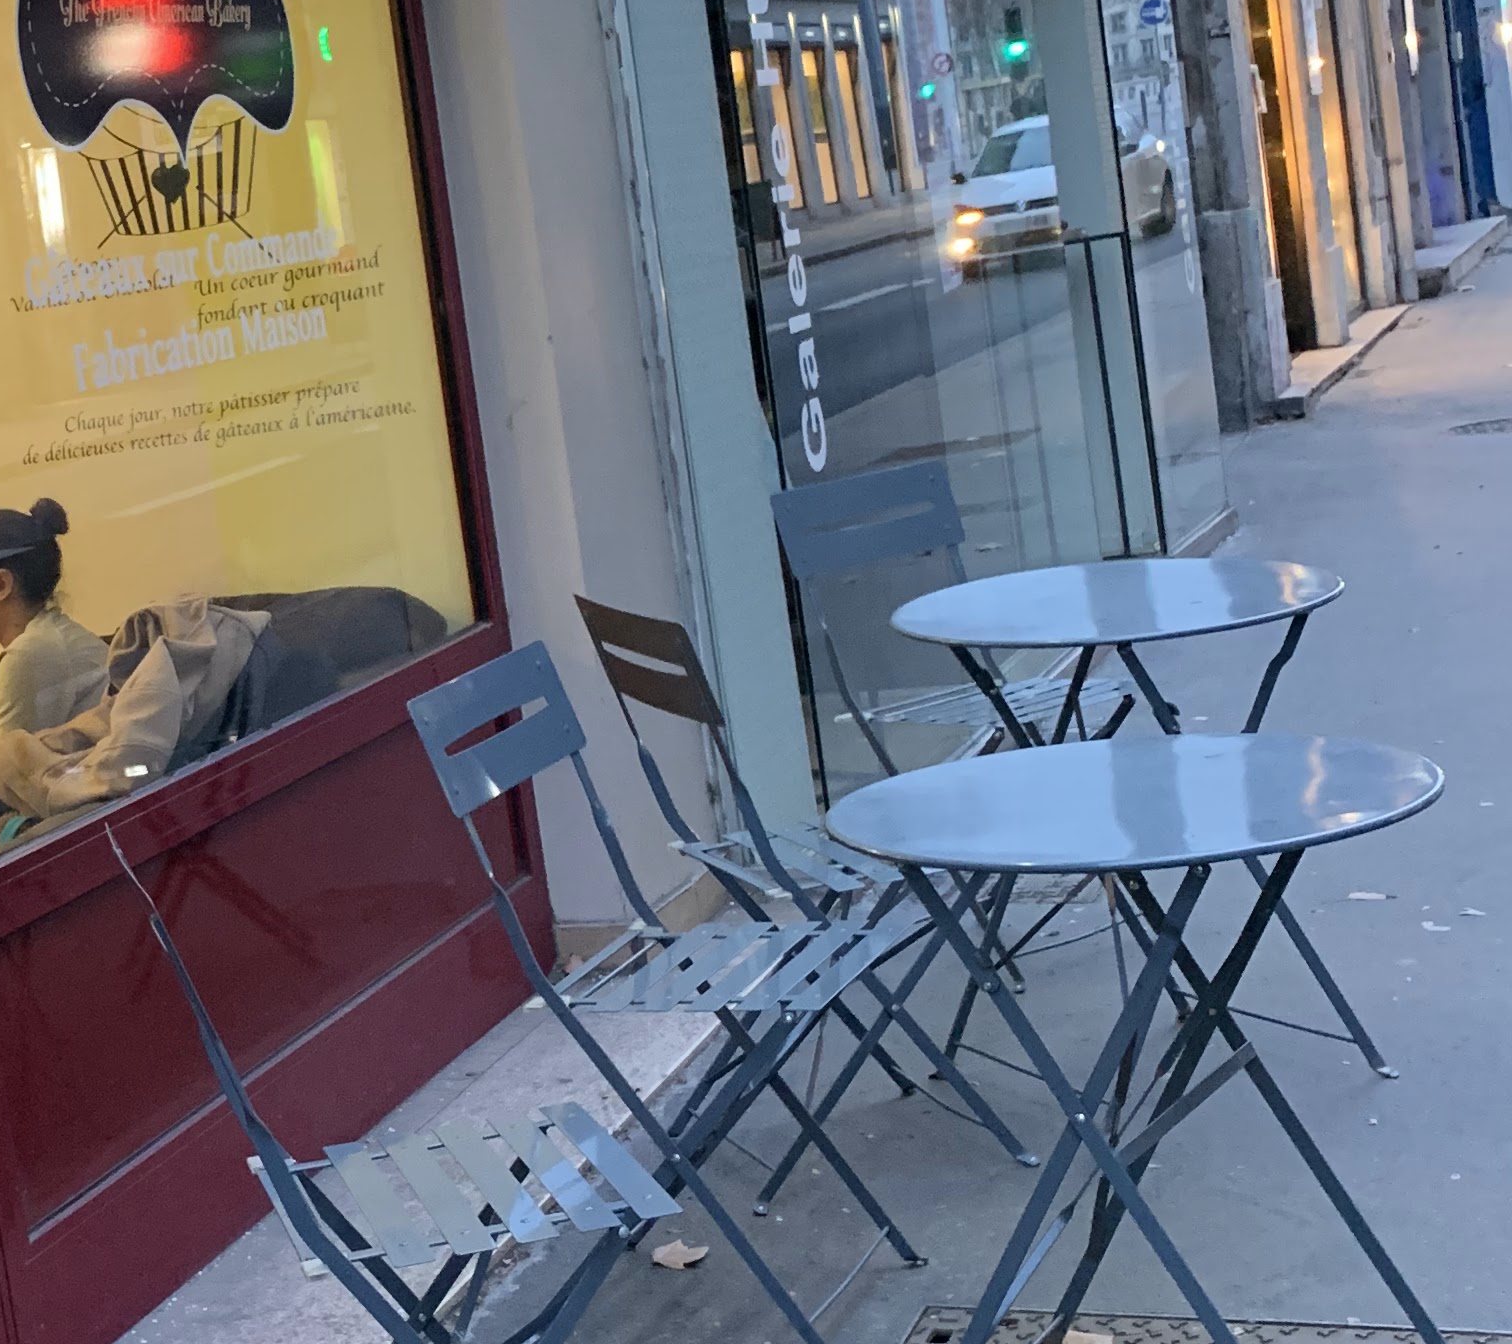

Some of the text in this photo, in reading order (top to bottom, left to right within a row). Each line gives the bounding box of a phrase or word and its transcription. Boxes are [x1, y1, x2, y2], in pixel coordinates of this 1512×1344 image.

[194, 243, 383, 297] Un coeur gourmand
[302, 281, 385, 312] croquant
[771, 124, 827, 472] Galerie
[72, 306, 328, 393] Fabrication Maison
[65, 410, 124, 435] Chaque
[172, 399, 214, 419] notre
[217, 387, 291, 421] pâtissier
[293, 379, 360, 409] prépare
[23, 444, 40, 465] de
[45, 438, 125, 463] délicieuses
[130, 432, 188, 450] recettes
[194, 420, 210, 443] de
[216, 417, 283, 448] gâteaux
